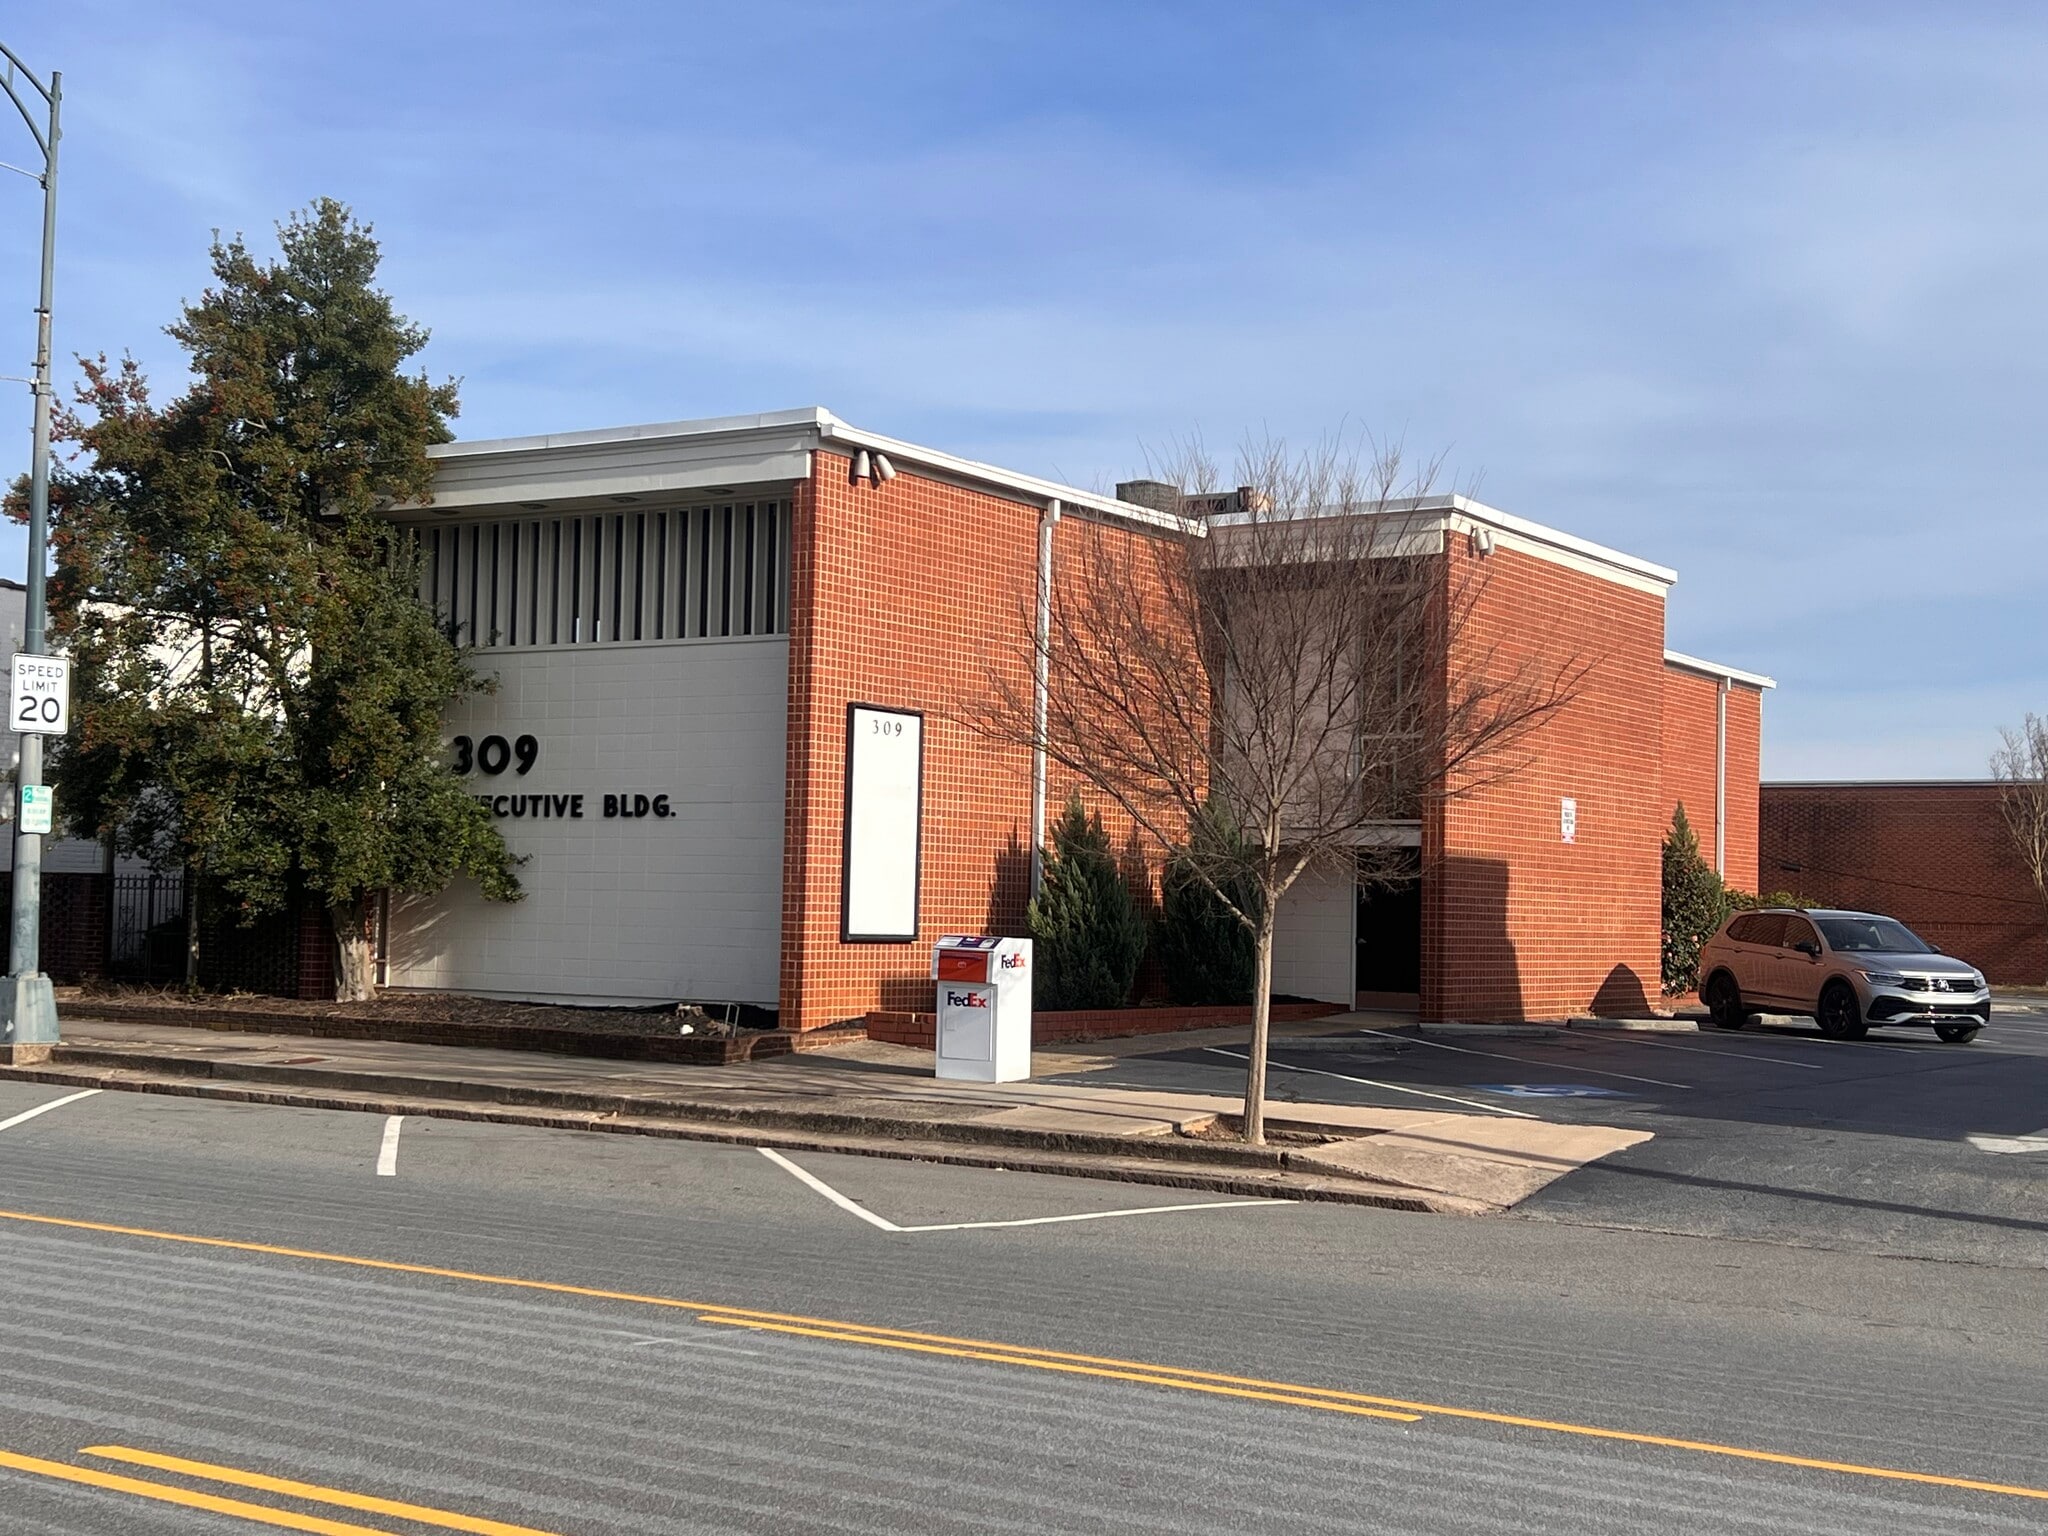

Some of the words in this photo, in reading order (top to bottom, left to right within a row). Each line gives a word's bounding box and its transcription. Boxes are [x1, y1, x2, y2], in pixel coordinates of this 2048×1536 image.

[18, 664, 63, 678] SPEED
[23, 680, 57, 692] LIMIT
[19, 696, 60, 723] 20
[872, 719, 902, 737] 309
[452, 734, 539, 776] 309
[473, 794, 584, 818] ECUTIVE
[603, 794, 677, 818] BLDG.
[1001, 953, 1026, 968] FedEx
[947, 991, 987, 1008] FedEx
